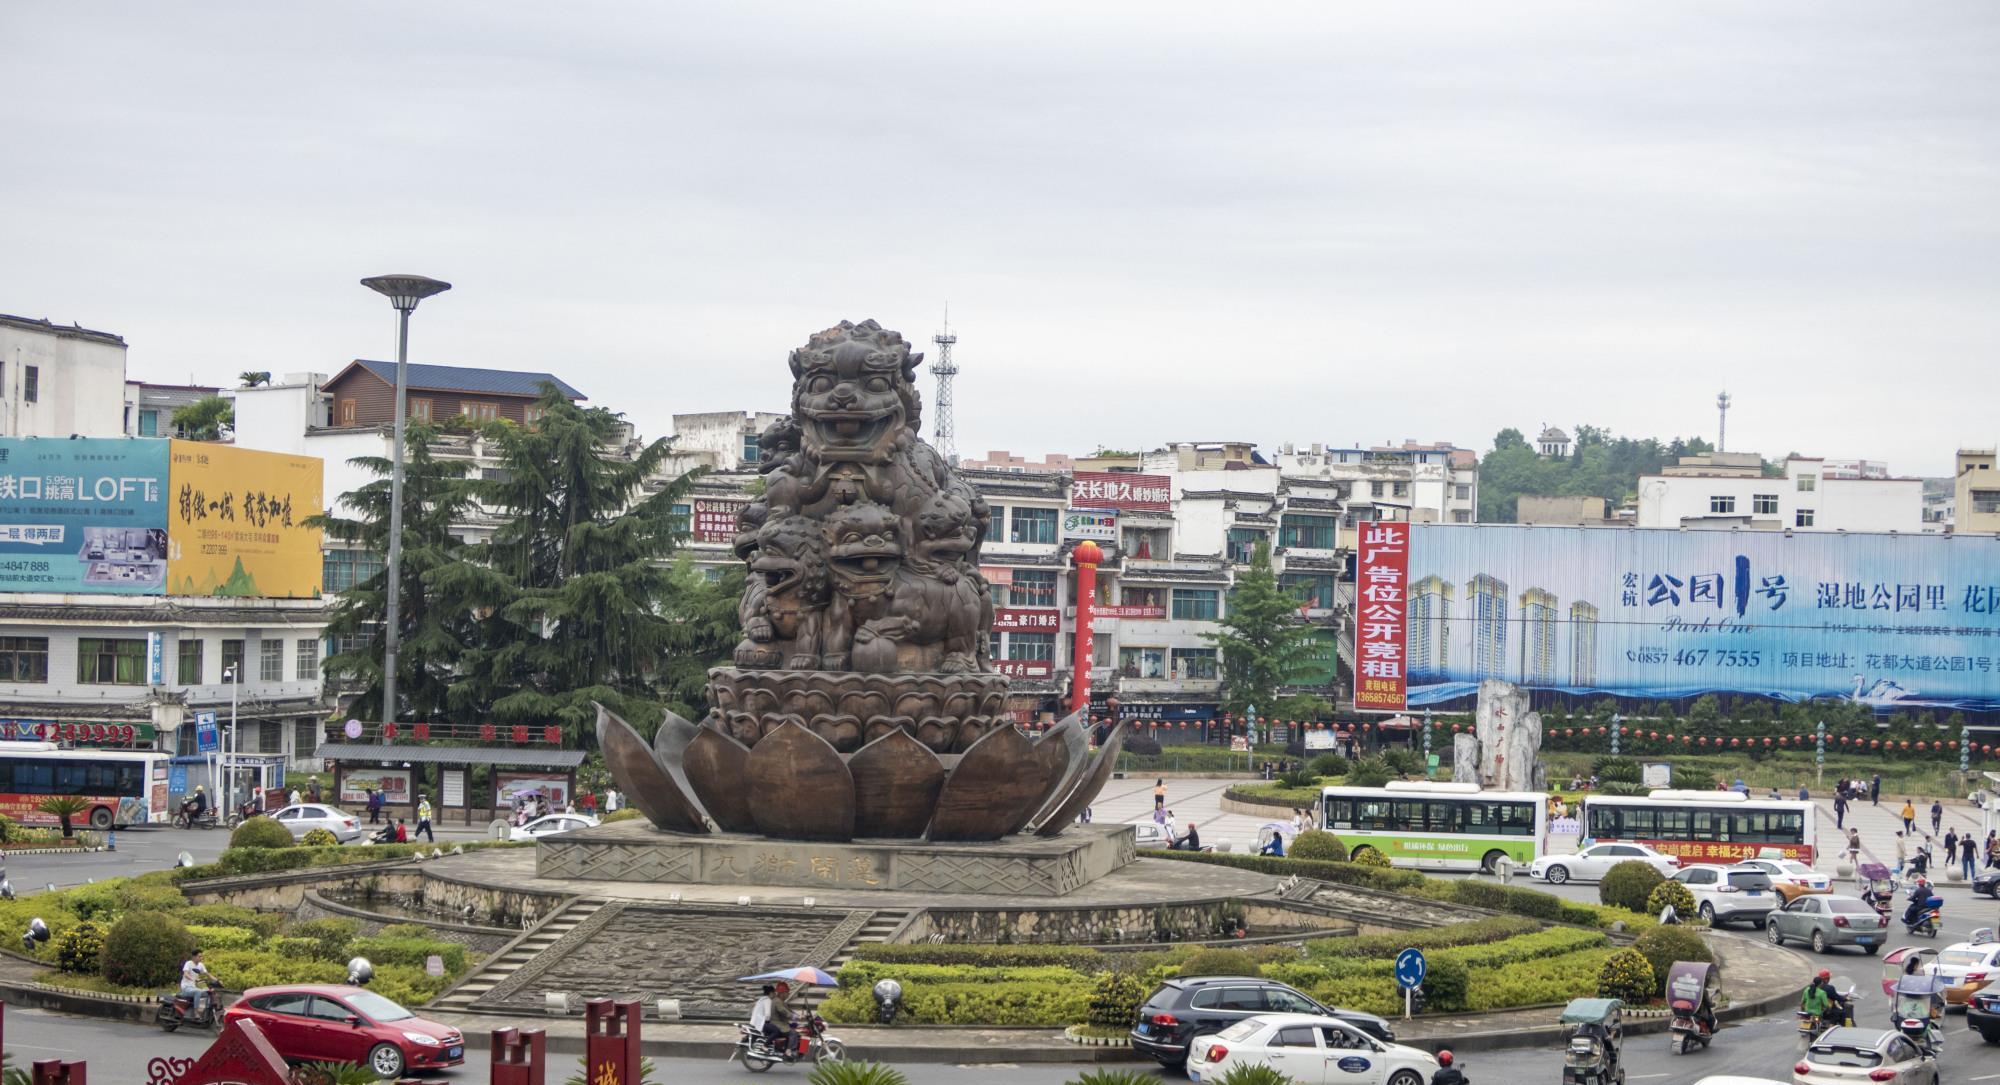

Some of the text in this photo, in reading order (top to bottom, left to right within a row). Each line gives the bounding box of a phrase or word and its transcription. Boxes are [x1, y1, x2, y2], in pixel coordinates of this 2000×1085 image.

[45, 485, 75, 501] 挑高
[78, 476, 158, 502] LOFT
[1074, 480, 1132, 502] 天长地久
[1647, 554, 1790, 619] 公园1号
[1362, 527, 1404, 678] 此广告位公开竞租
[1816, 581, 1948, 613] 湿地公园里
[1018, 614, 1057, 627] 豪门婚庆
[1661, 614, 1711, 634] Park
[1638, 648, 1761, 668] 0857 467 7555
[1865, 653, 1993, 673] 花都大道公园1号
[1706, 845, 1755, 859] 幸福之约
